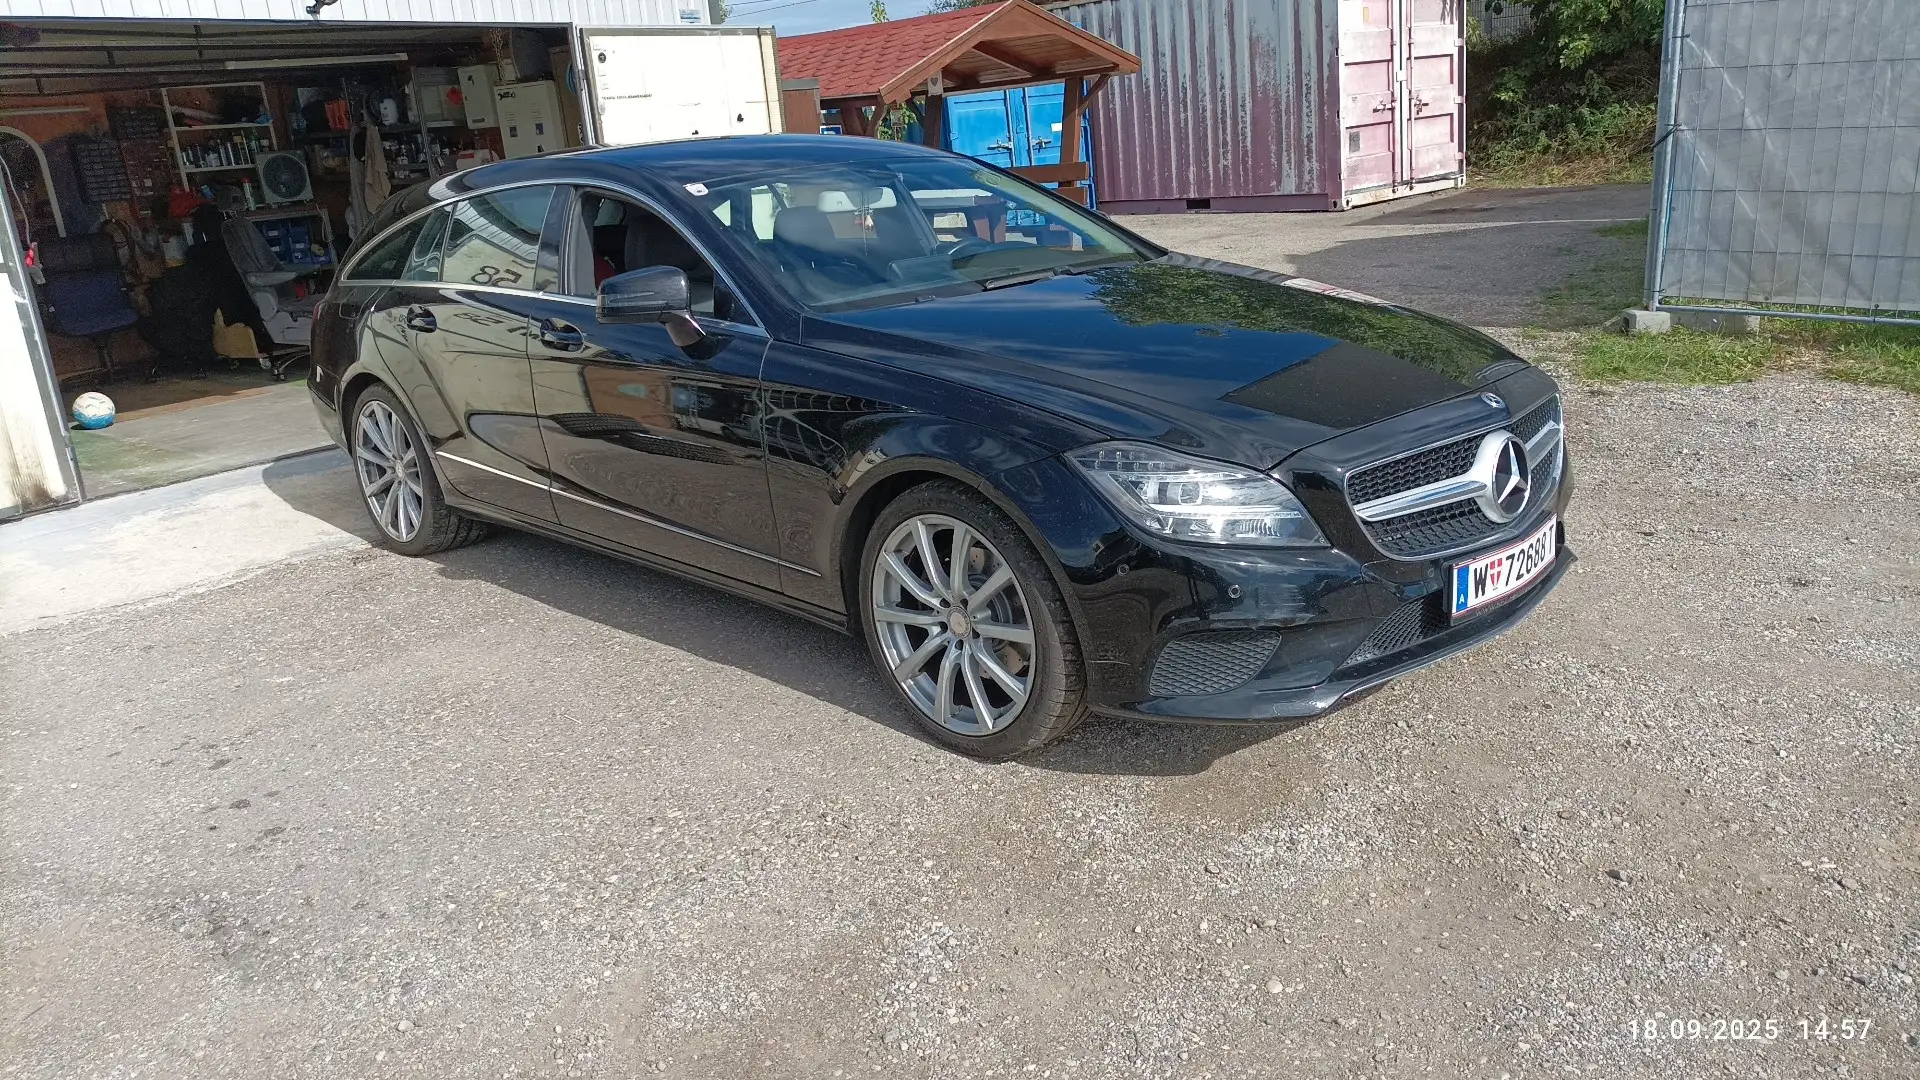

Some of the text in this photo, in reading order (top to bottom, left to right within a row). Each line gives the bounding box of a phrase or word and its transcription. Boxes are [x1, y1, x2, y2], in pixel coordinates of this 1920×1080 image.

[1473, 563, 1490, 599] W
[1505, 530, 1547, 587] 72688
[1458, 593, 1465, 605] A
